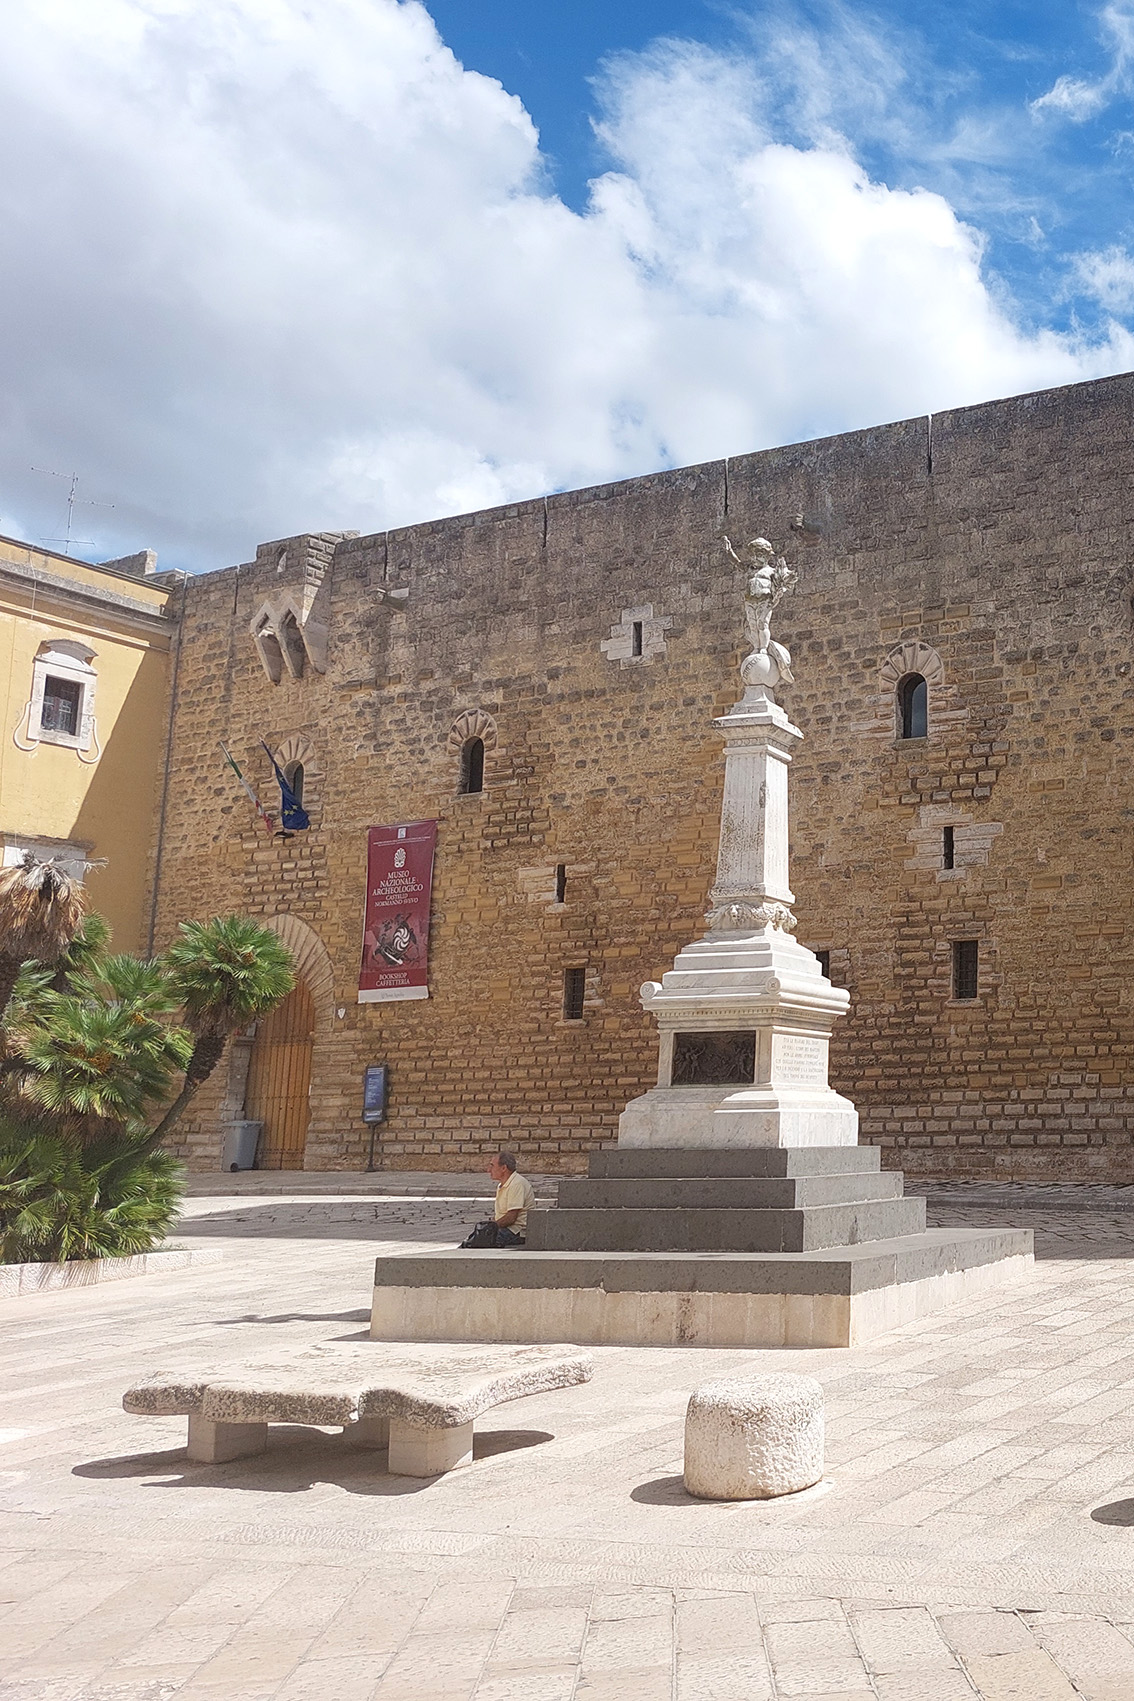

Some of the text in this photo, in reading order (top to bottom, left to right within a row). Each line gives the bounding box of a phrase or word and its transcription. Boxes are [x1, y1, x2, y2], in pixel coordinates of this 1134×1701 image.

[387, 870, 409, 879] MUSEO
[380, 877, 416, 888] NAZIONALE
[372, 884, 423, 896] ARCHEOLOGICO
[379, 972, 407, 980] BOOKSHOP
